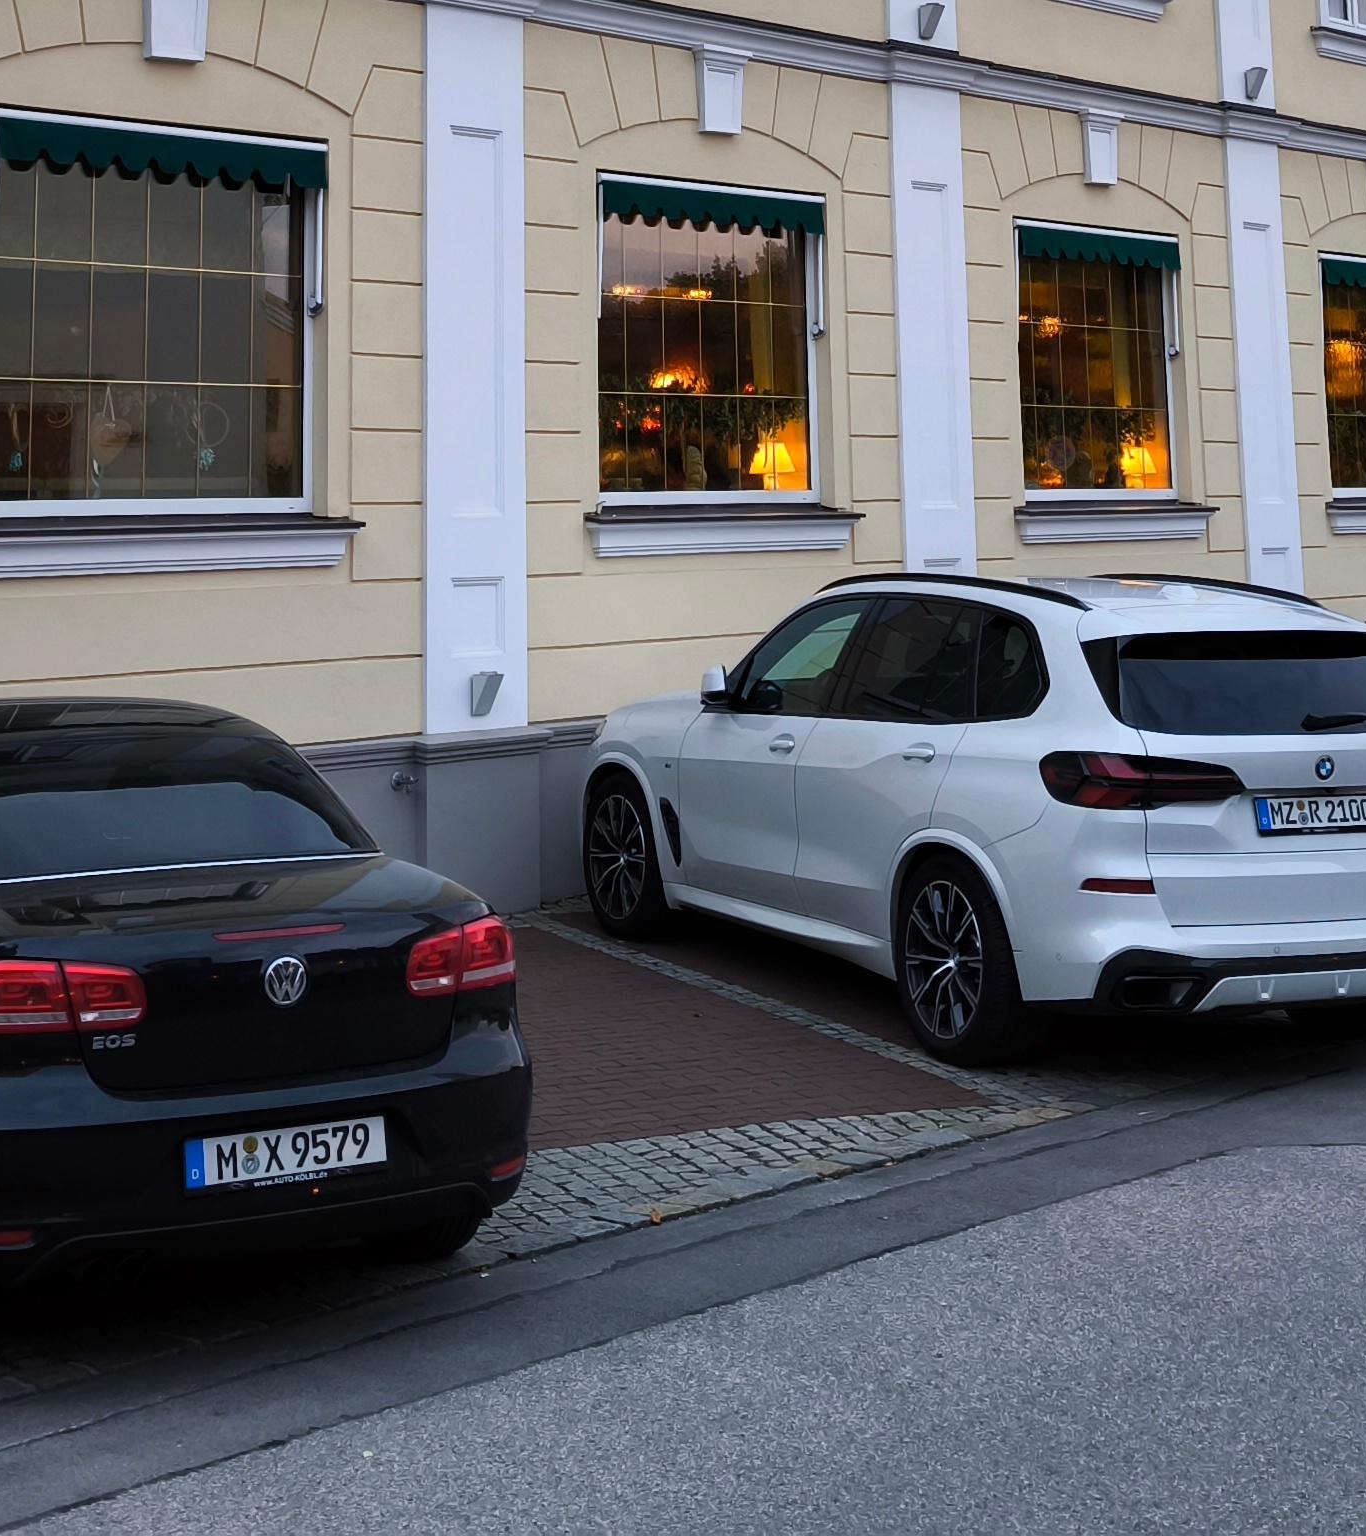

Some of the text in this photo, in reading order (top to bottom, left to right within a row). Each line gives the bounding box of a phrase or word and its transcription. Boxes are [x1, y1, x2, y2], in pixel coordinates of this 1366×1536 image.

[1269, 801, 1297, 825] MZ
[1308, 800, 1323, 823] R
[92, 1034, 136, 1050] EOS
[216, 1142, 239, 1180] M
[263, 1135, 285, 1173] X
[291, 1123, 370, 1169] 9579
